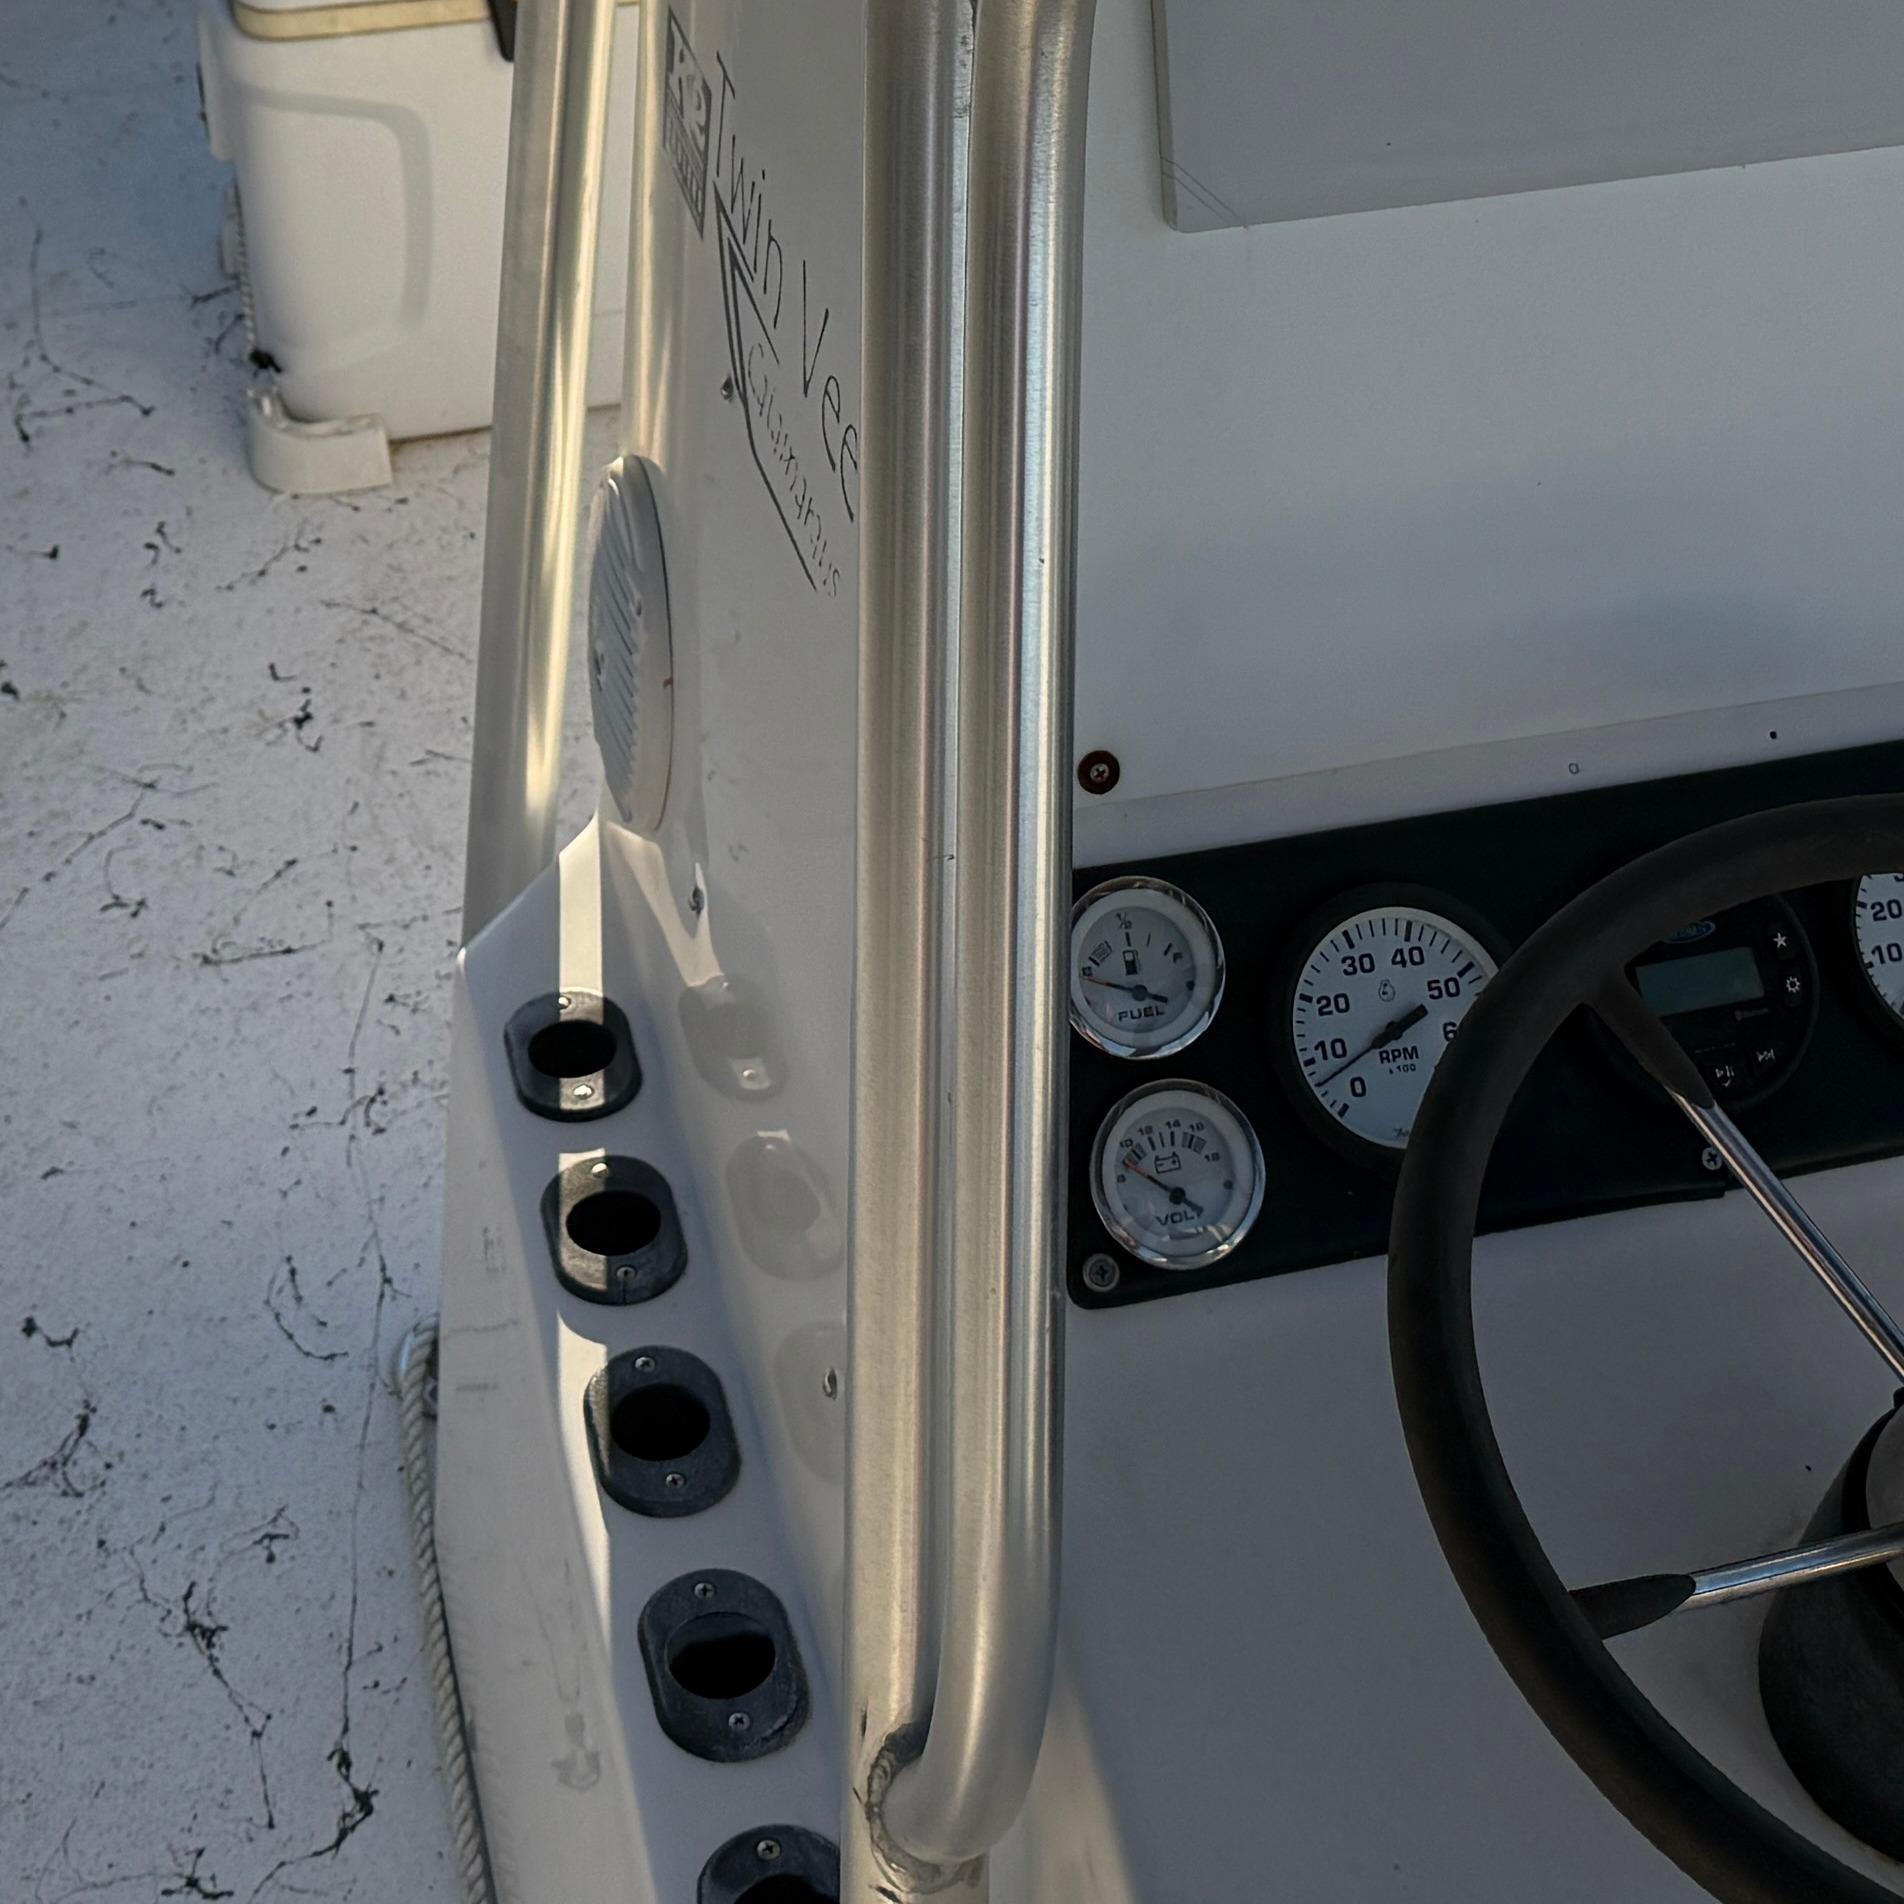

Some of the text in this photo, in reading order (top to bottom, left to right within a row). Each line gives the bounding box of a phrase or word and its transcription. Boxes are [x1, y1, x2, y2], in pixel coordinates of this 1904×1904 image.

[716, 49, 858, 523] Twin Vee
[1870, 898, 1903, 922] 20
[1341, 953, 1375, 976] 30
[1391, 946, 1425, 969] 40
[1872, 942, 1903, 965] 10
[1427, 976, 1461, 1001] 50
[1118, 1005, 1166, 1022] FUEL
[1316, 993, 1350, 1016] 20
[1314, 1038, 1347, 1062] 10
[1379, 1046, 1419, 1065] RPM
[1350, 1076, 1367, 1098] 0
